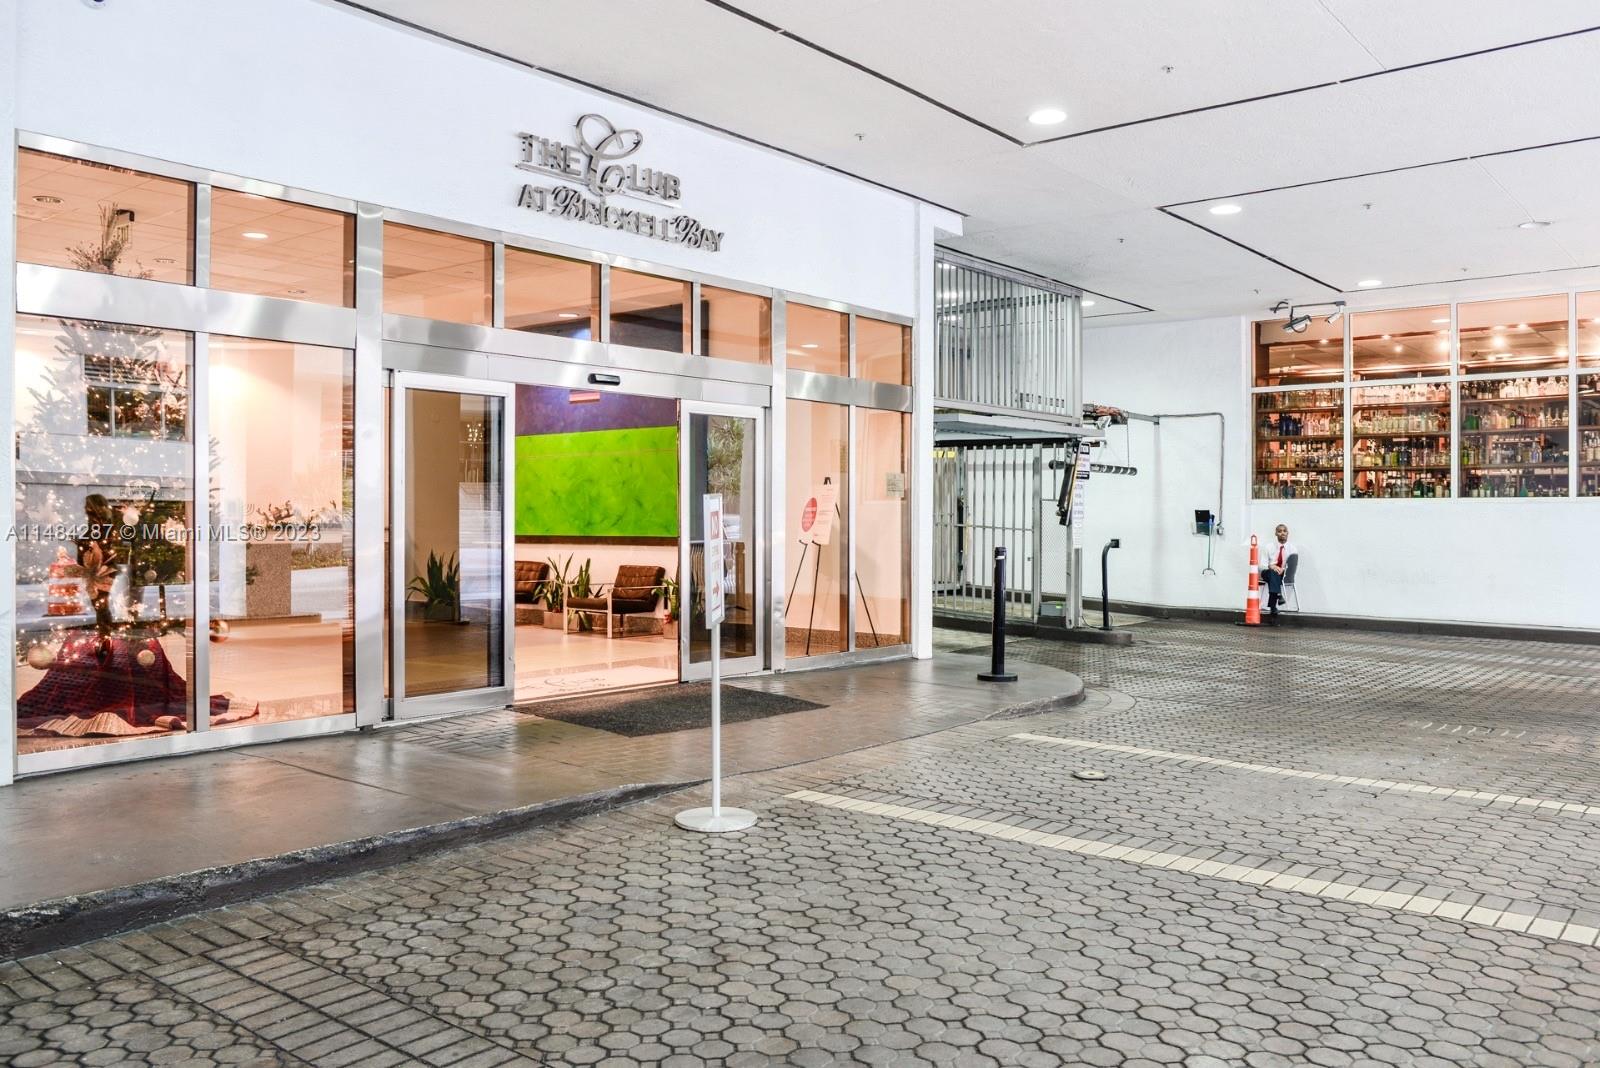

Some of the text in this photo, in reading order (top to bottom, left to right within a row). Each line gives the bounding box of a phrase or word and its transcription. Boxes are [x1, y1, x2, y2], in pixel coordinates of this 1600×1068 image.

[518, 113, 682, 201] THE CLUB
[517, 184, 725, 253] AT BRICKELL BAY
